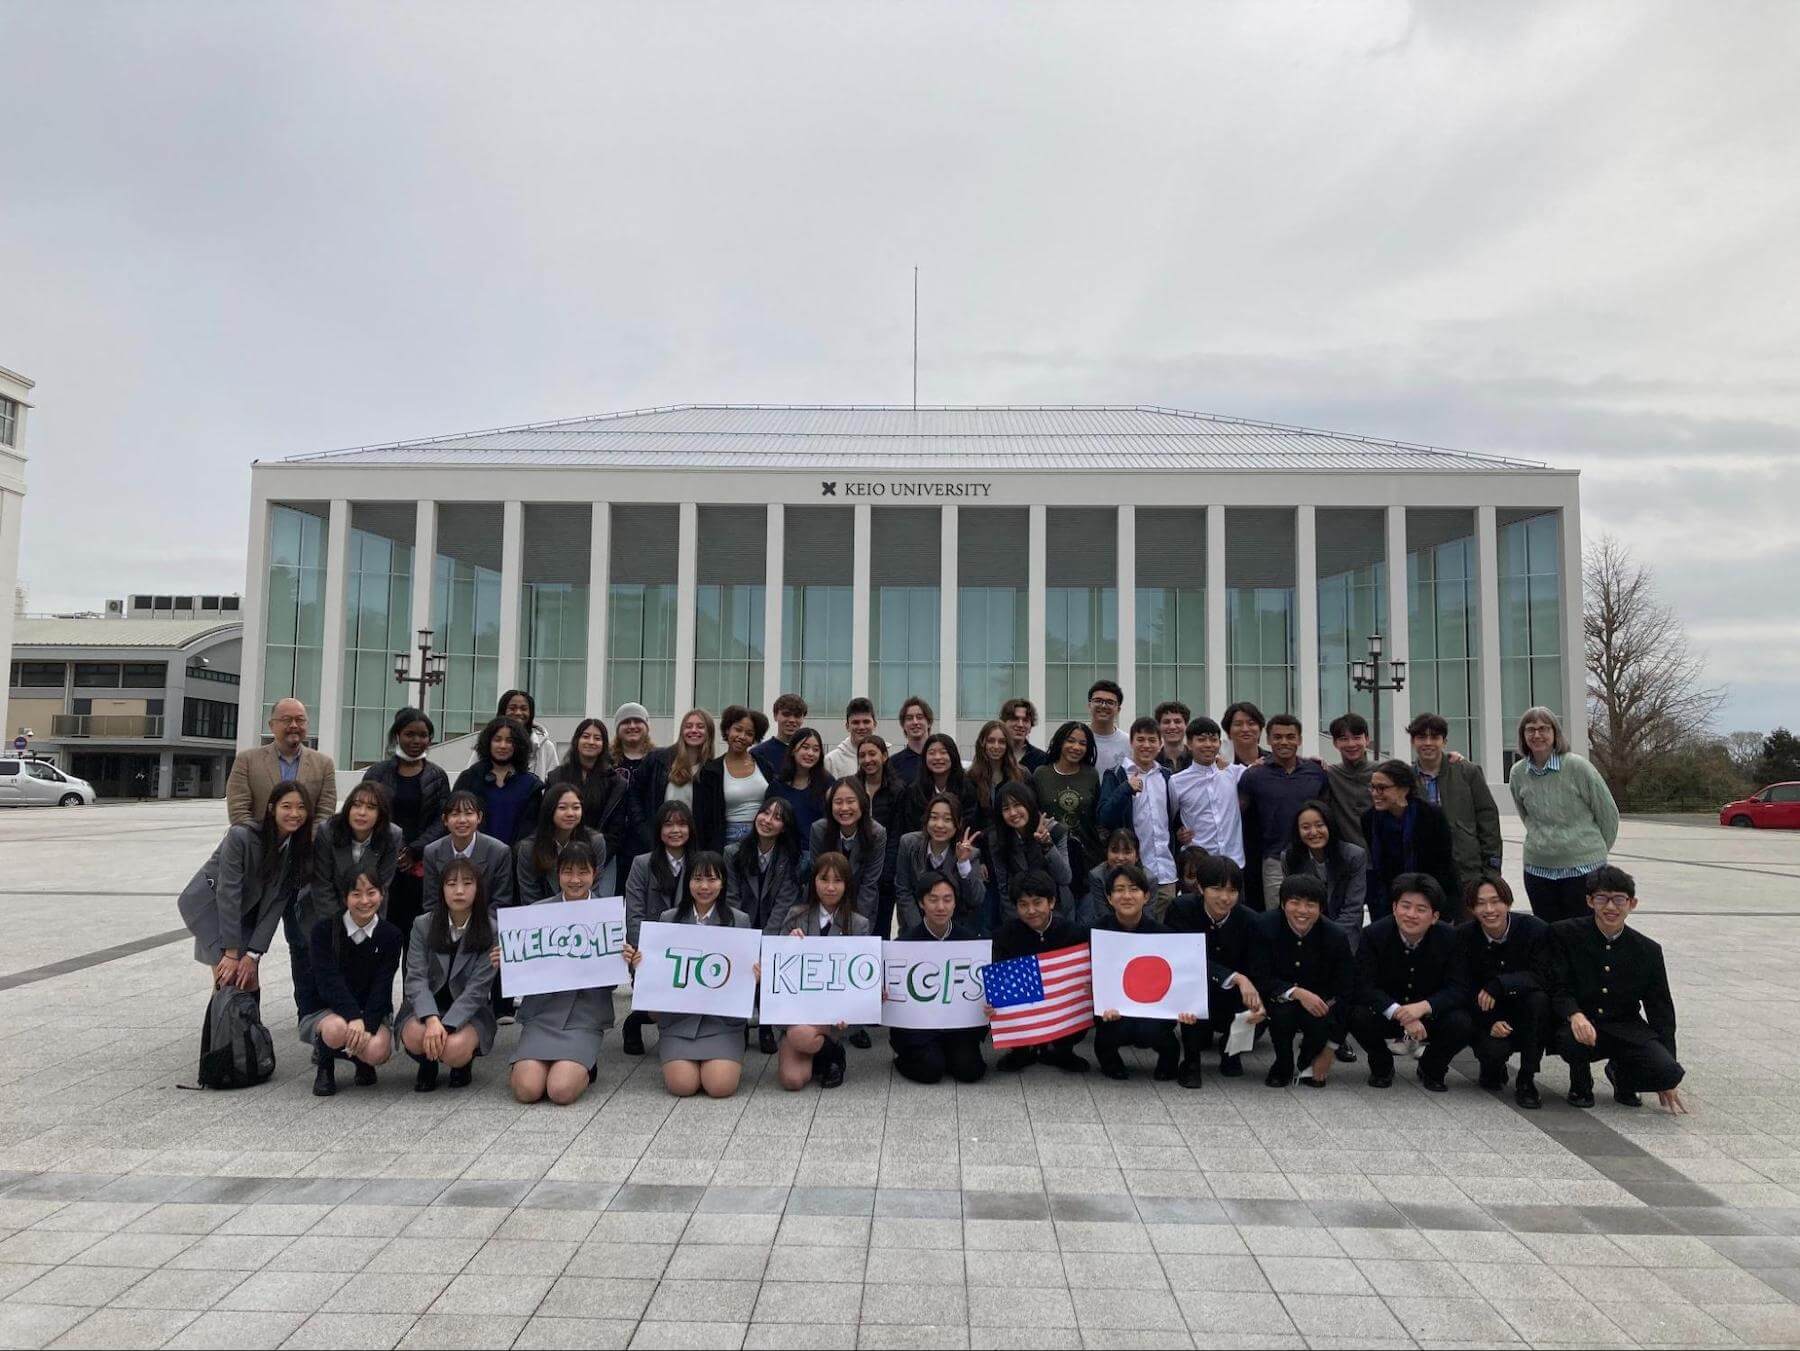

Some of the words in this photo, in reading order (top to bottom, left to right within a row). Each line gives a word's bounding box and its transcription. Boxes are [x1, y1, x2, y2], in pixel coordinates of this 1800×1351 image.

[845, 483, 886, 496] KEIO
[891, 483, 992, 496] UNIVERSITY
[500, 920, 624, 963] WELCOME
[665, 946, 731, 989] TO
[772, 952, 882, 995] KEIO
